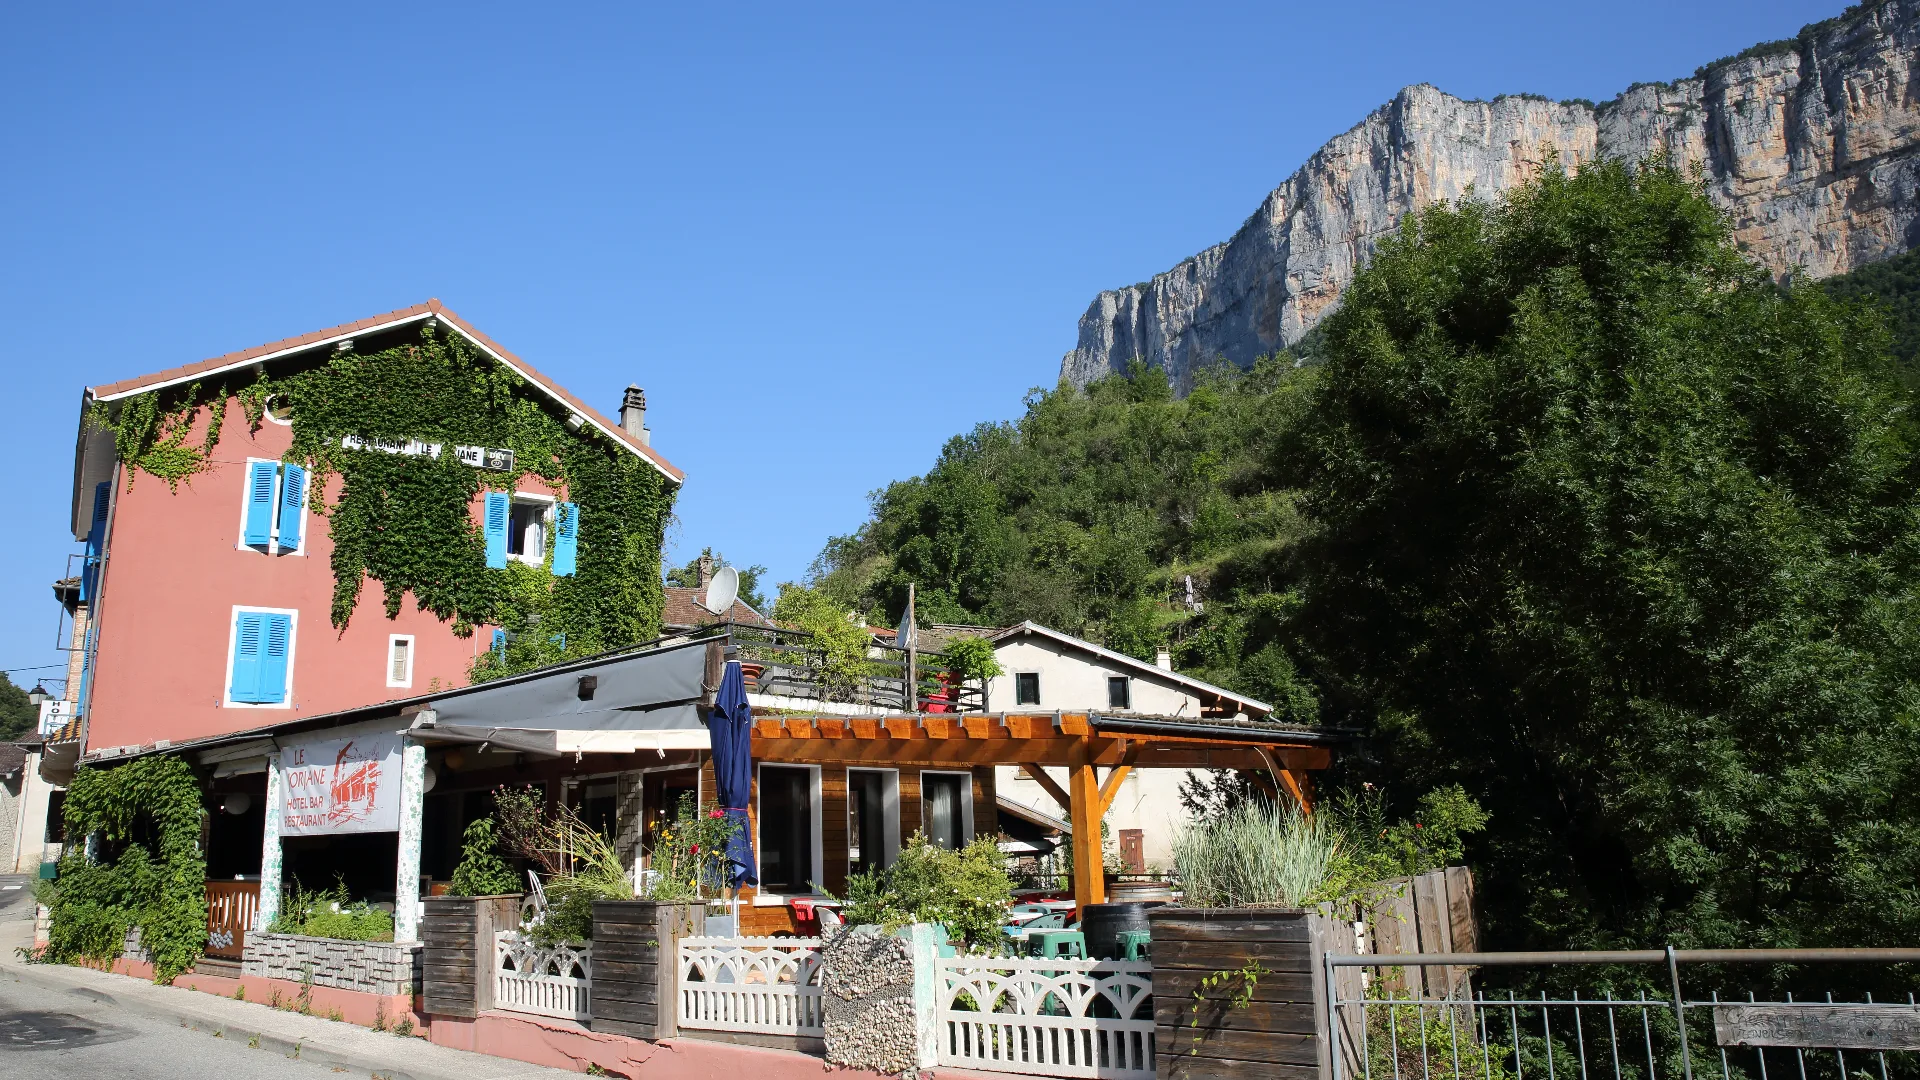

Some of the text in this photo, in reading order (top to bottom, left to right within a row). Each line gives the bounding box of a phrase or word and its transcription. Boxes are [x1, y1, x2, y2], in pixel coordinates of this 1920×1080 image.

[421, 443, 432, 454] LE
[294, 749, 305, 765] LE
[286, 796, 324, 810] HOTEL BAR
[284, 813, 326, 828] RESTAURANT
